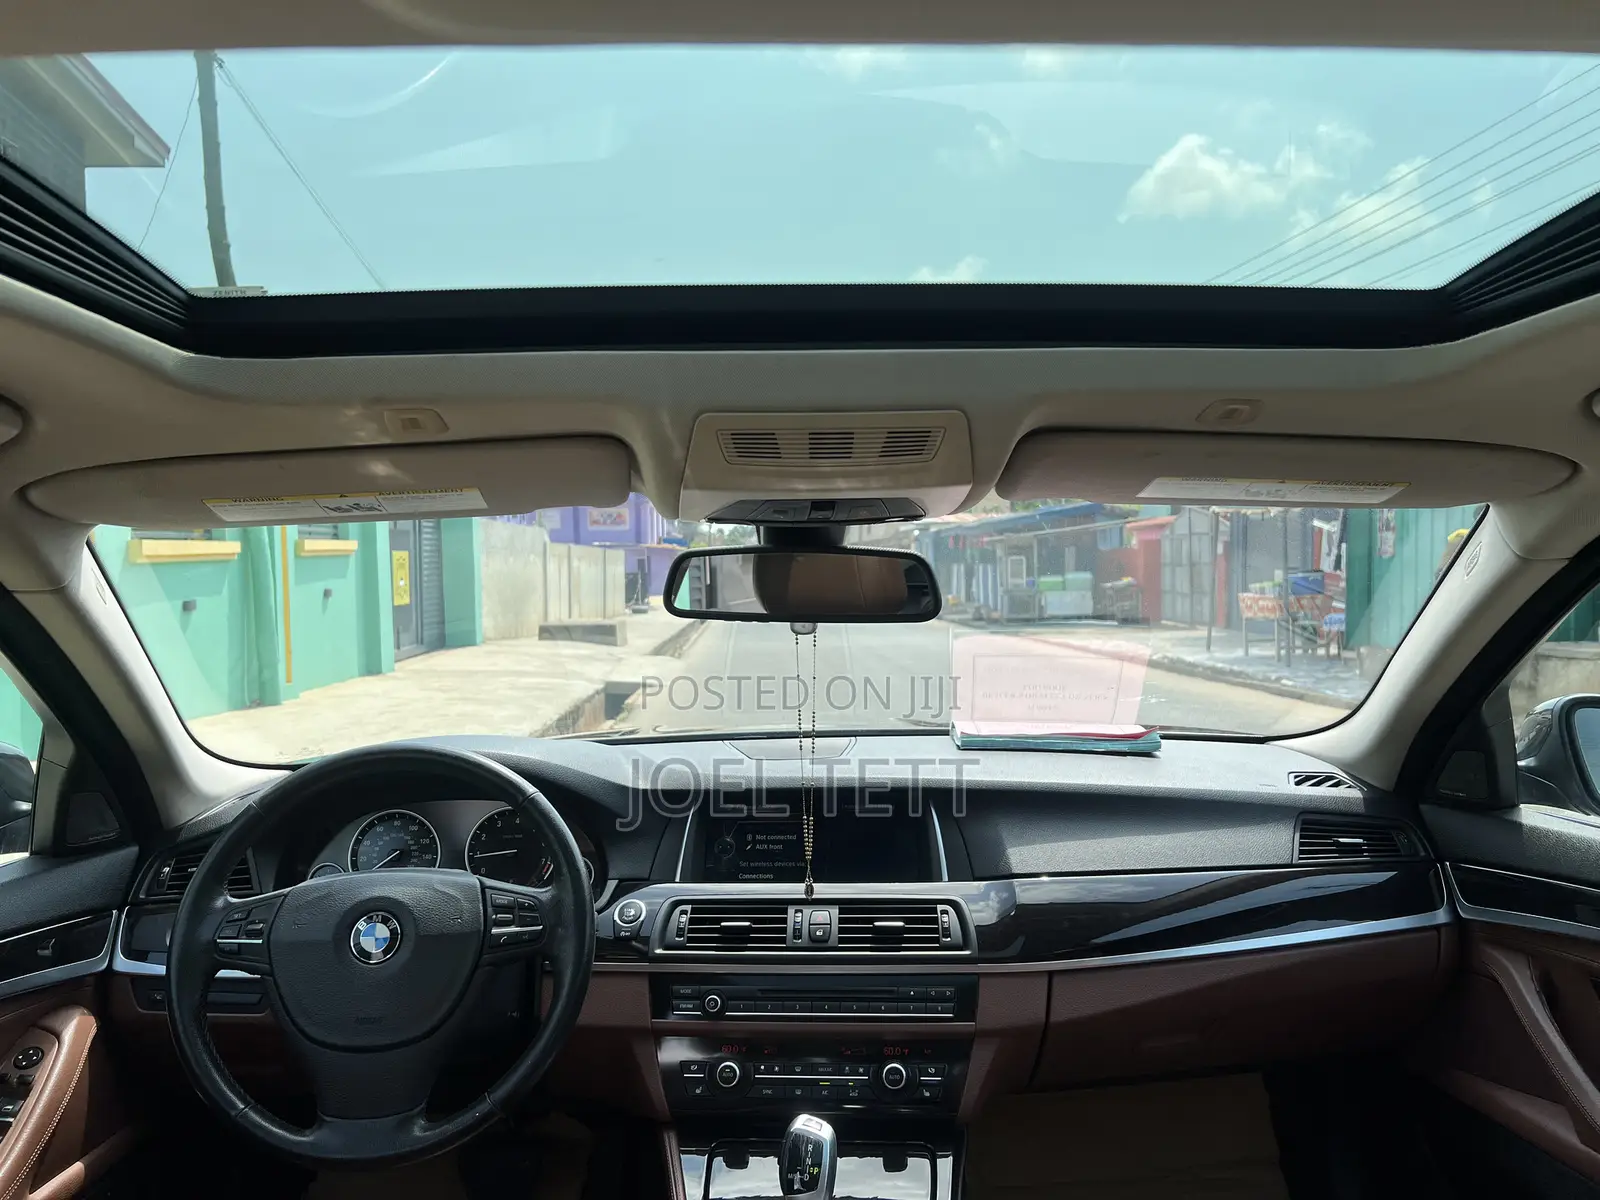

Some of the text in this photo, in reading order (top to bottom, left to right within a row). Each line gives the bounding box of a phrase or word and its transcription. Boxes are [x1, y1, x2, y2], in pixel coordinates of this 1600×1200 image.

[357, 914, 397, 931] BMW
[883, 1046, 901, 1056] 60.0
[807, 1144, 813, 1152] R
[805, 1157, 812, 1165] N
[813, 1167, 819, 1175] P
